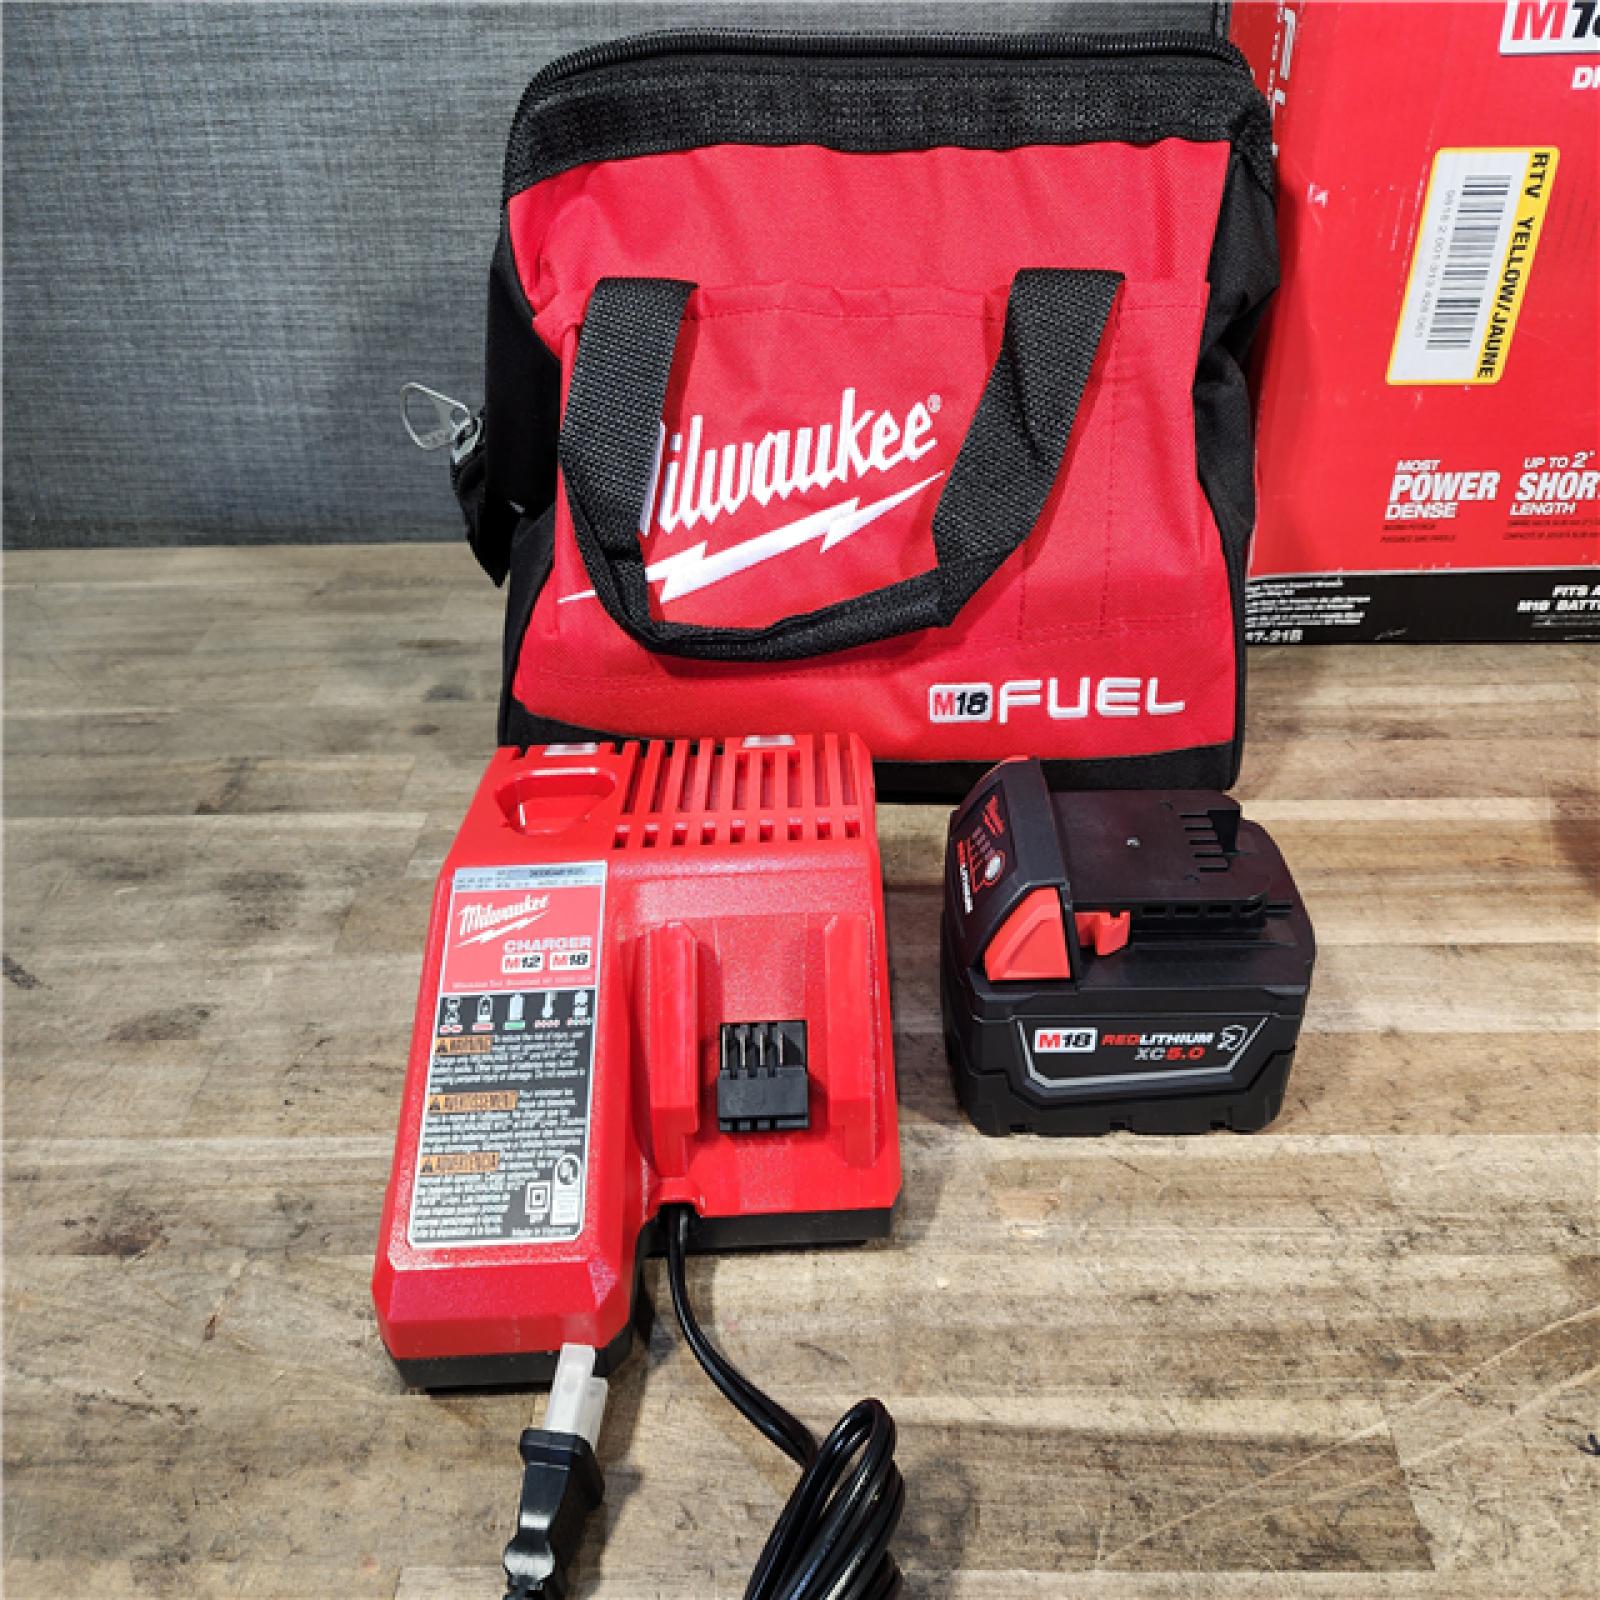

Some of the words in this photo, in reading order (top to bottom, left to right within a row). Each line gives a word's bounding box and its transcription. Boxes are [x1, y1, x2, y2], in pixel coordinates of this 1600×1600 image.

[1524, 152, 1550, 199] RTV
[1477, 216, 1536, 379] YELLOW/JAUNE
[639, 387, 938, 536] ilwaukee
[1523, 456, 1546, 470] UP
[1549, 456, 1569, 469] TO
[1389, 471, 1501, 501] POWER
[1514, 470, 1600, 501] SHOR
[1384, 501, 1459, 520] DENSE
[1509, 502, 1577, 516] LENGTH
[933, 690, 989, 717] M18
[998, 676, 1186, 724] FUEL
[503, 935, 593, 955] CHARGER
[1037, 1031, 1094, 1049] M18
[1101, 1031, 1215, 1047] REDLITHIUM
